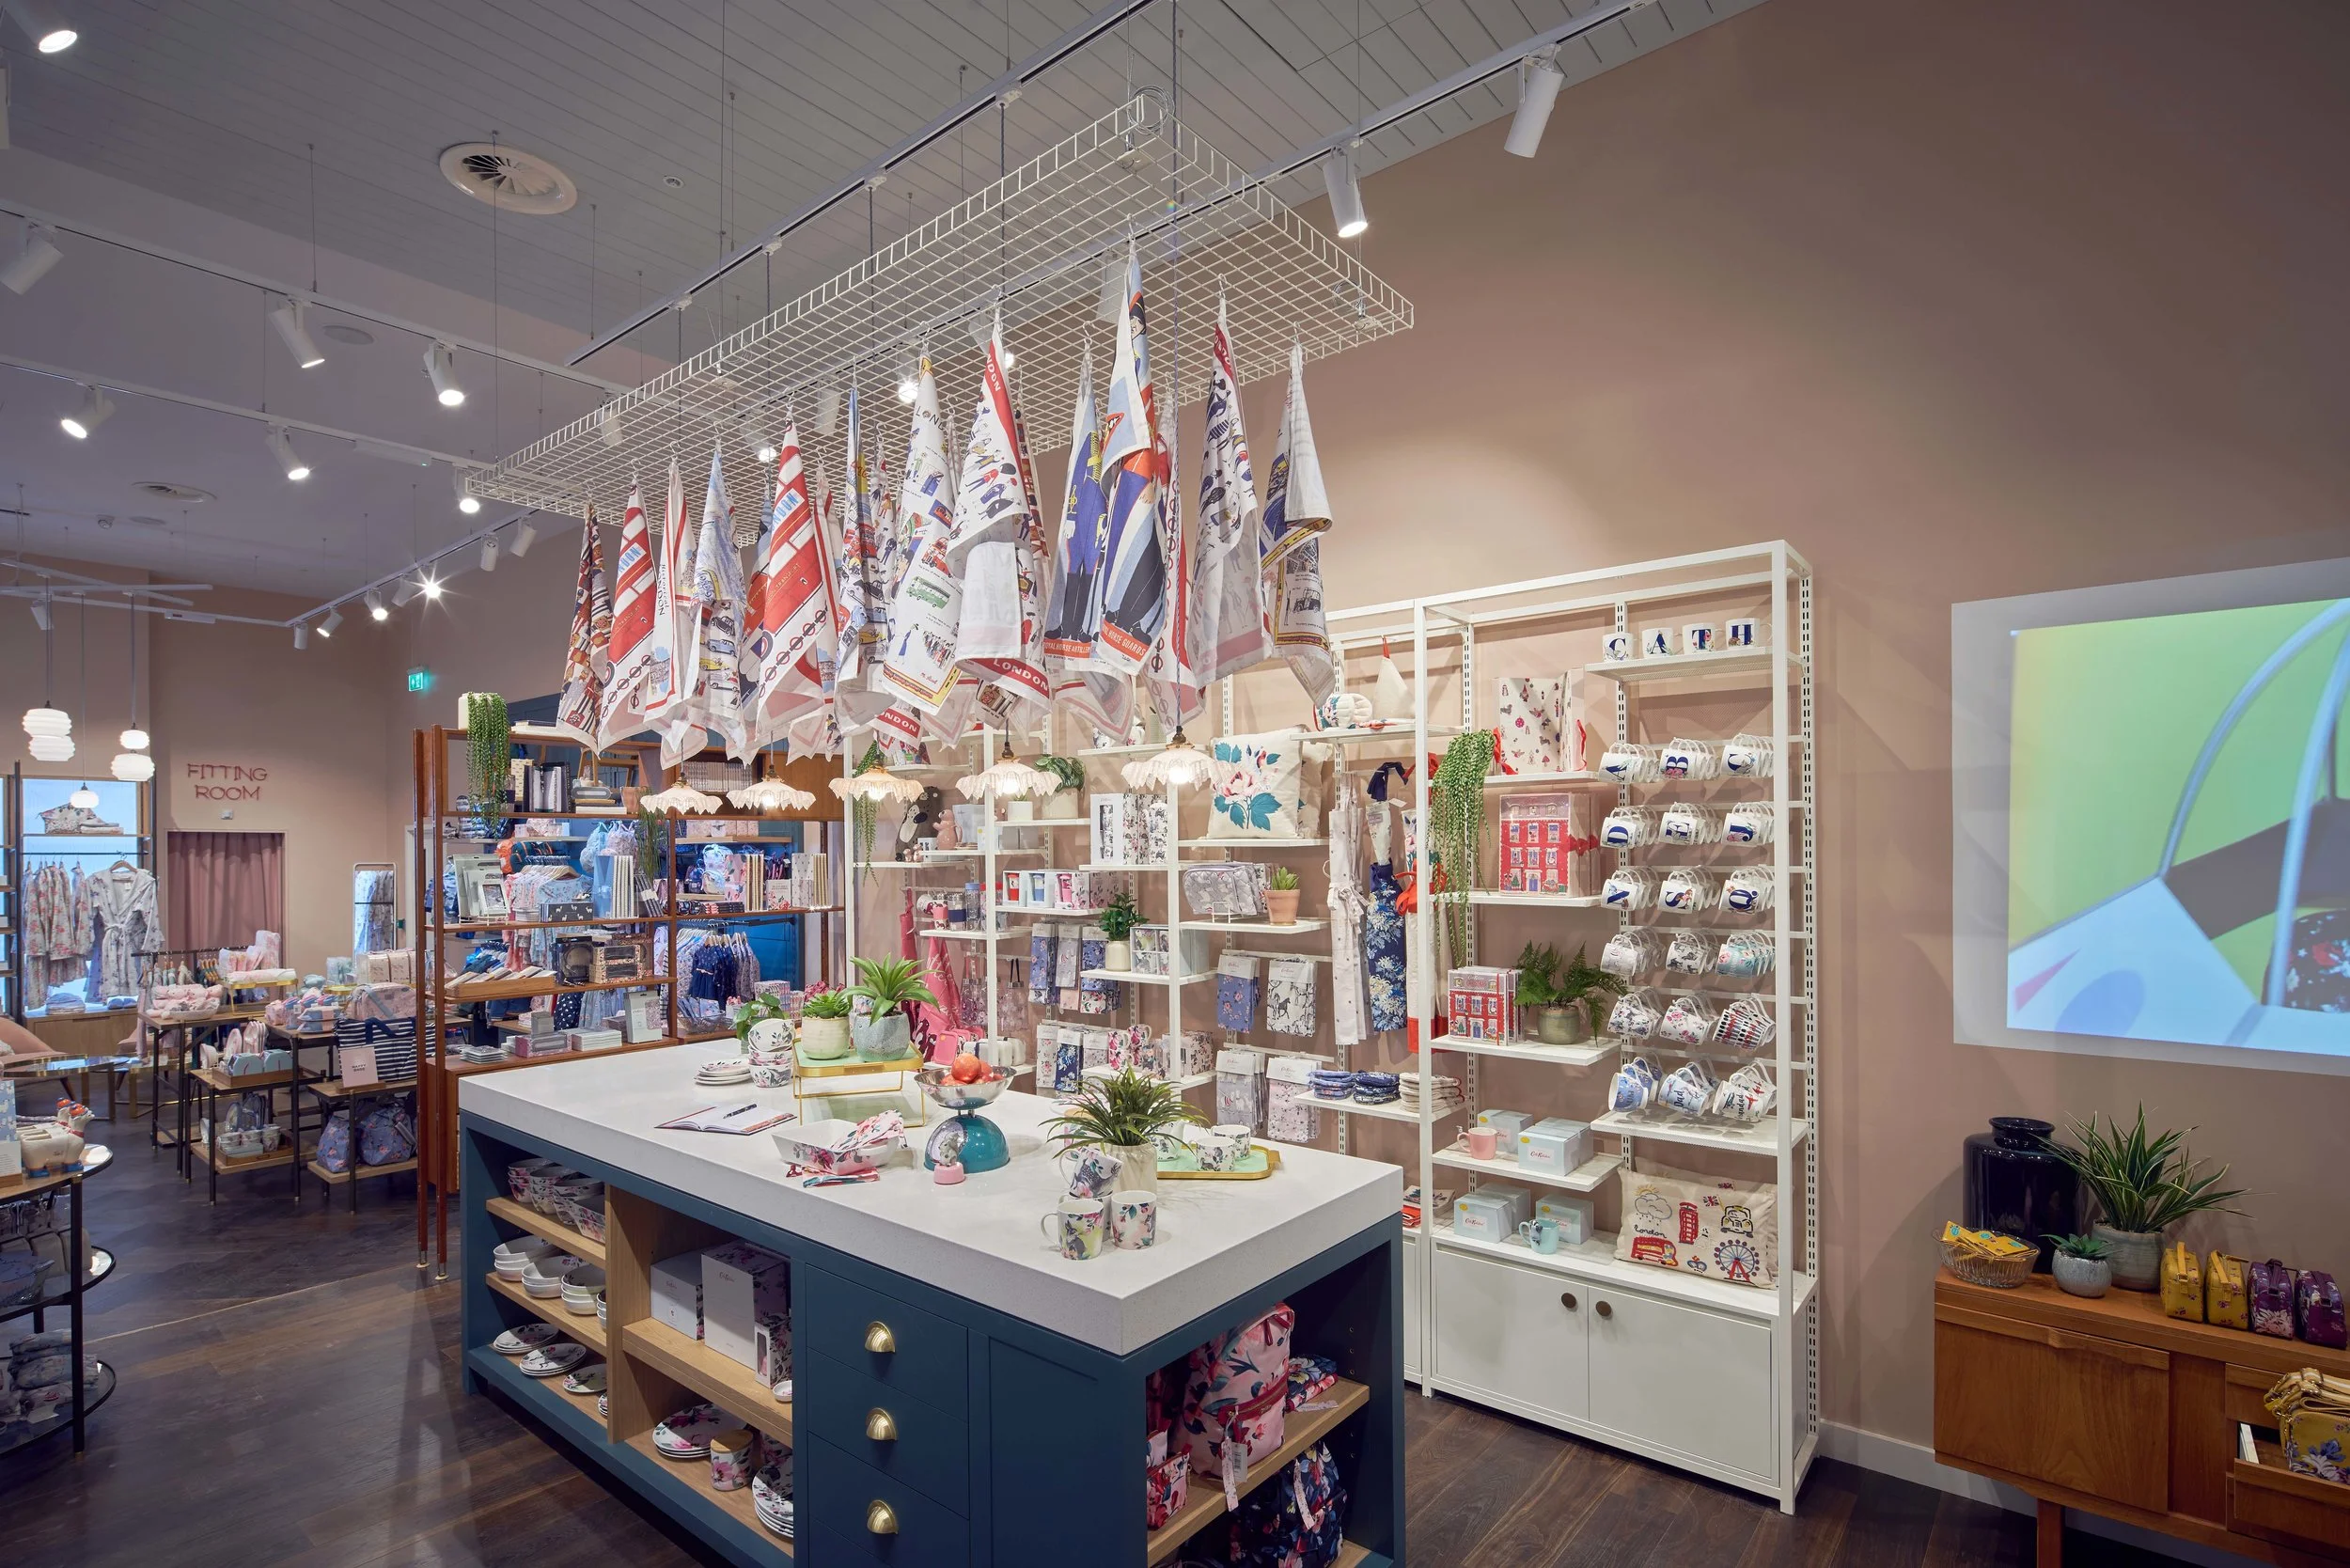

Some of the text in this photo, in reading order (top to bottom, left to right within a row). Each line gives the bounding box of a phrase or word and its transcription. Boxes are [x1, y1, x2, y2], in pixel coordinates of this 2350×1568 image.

[1651, 632, 1667, 654] A
[1731, 624, 1752, 645] H
[1122, 636, 1147, 656] GUARDS
[993, 659, 1048, 691] LONDON
[187, 763, 268, 781] FITTING
[1667, 756, 1689, 775] B
[195, 785, 260, 801] ROOM
[1607, 825, 1629, 844] D
[1673, 1087, 1685, 1108] Dad
